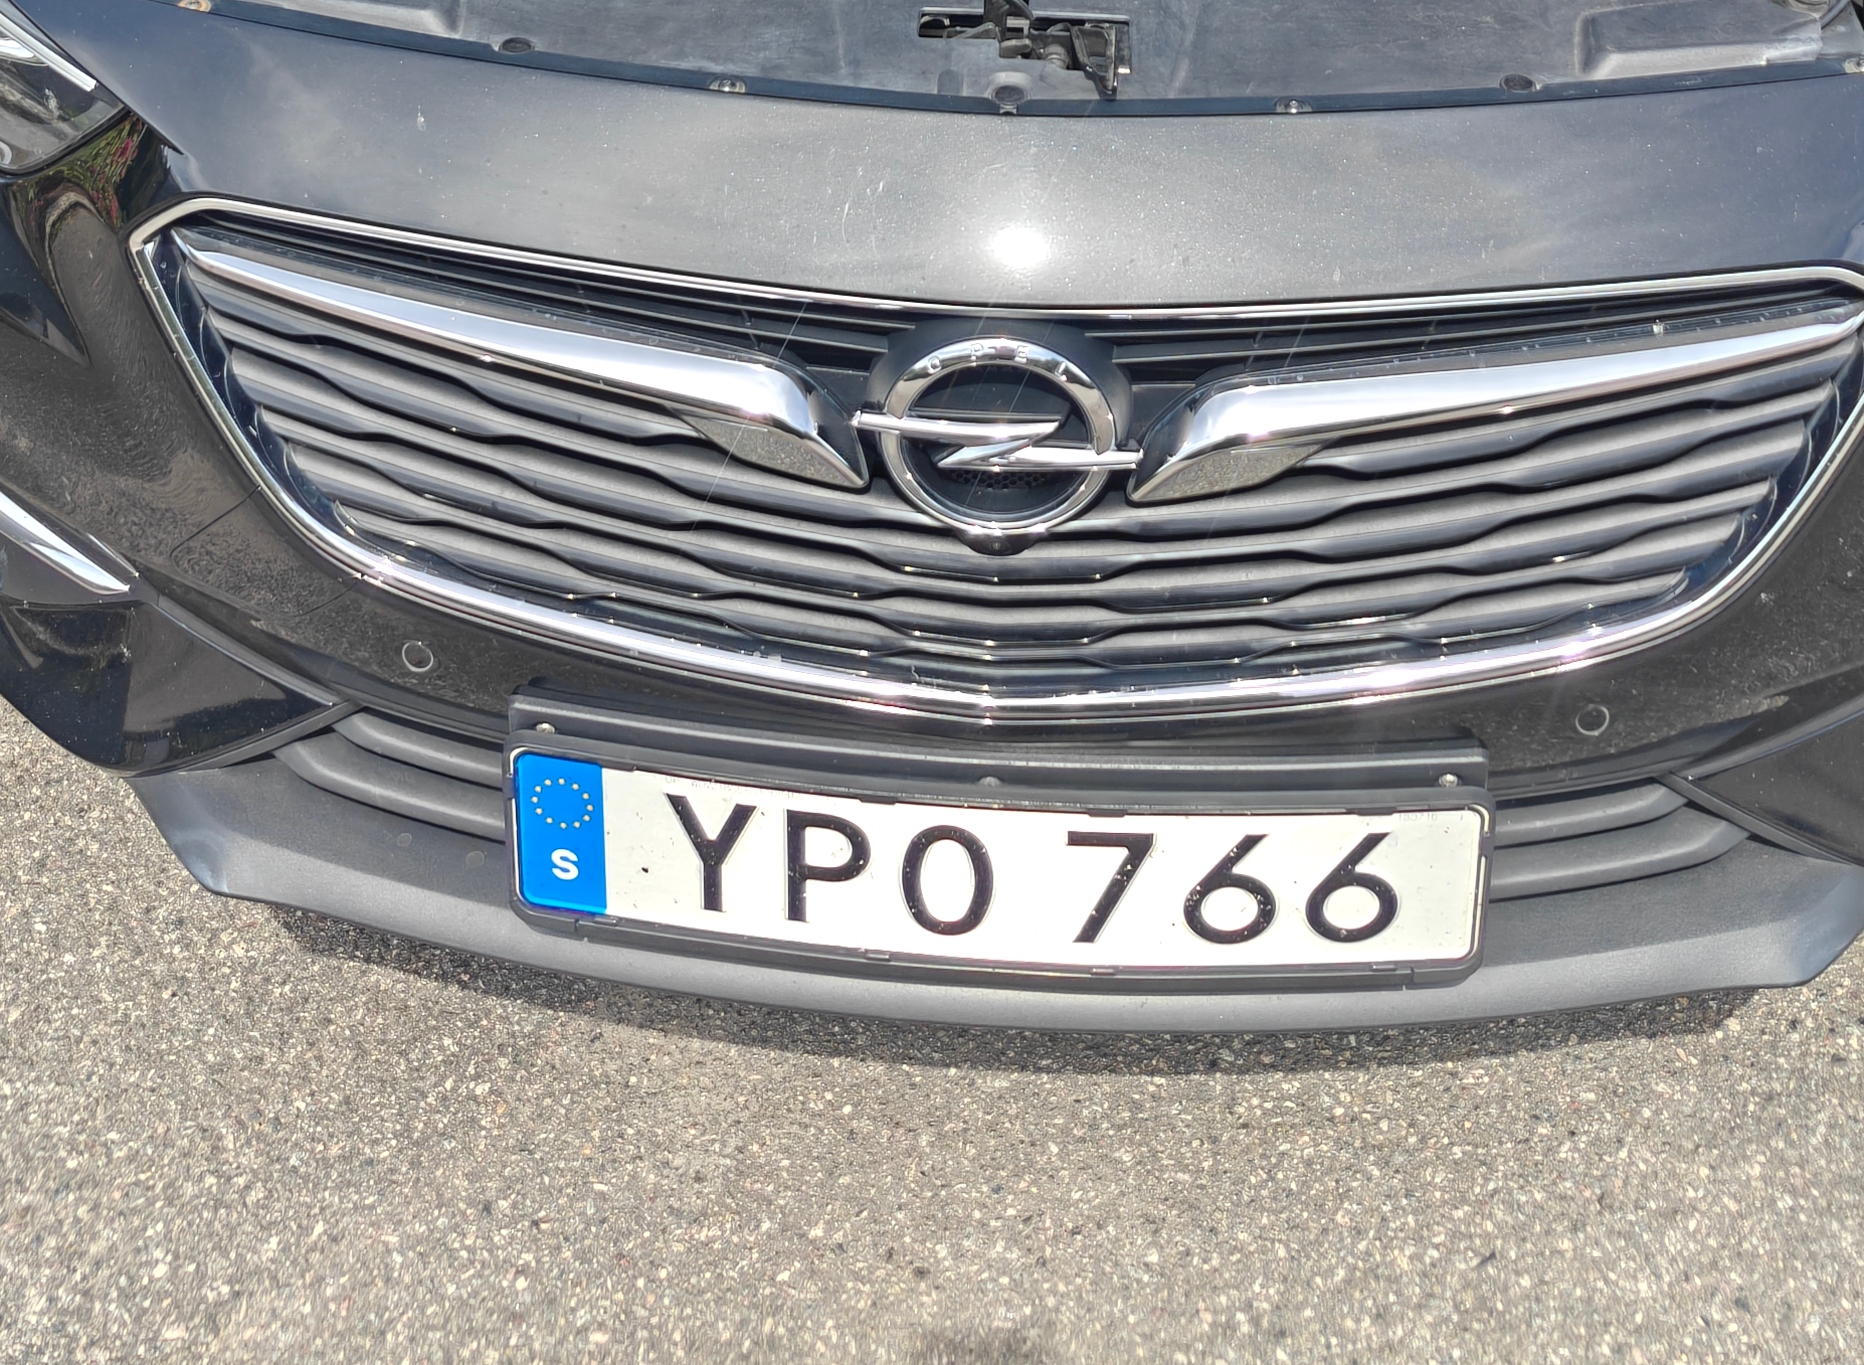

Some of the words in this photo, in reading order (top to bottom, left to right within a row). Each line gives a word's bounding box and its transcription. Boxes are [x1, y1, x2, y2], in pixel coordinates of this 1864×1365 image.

[927, 342, 1069, 382] OPEL
[551, 848, 580, 881] S
[662, 791, 995, 937] YPO
[1066, 829, 1399, 944] 766
